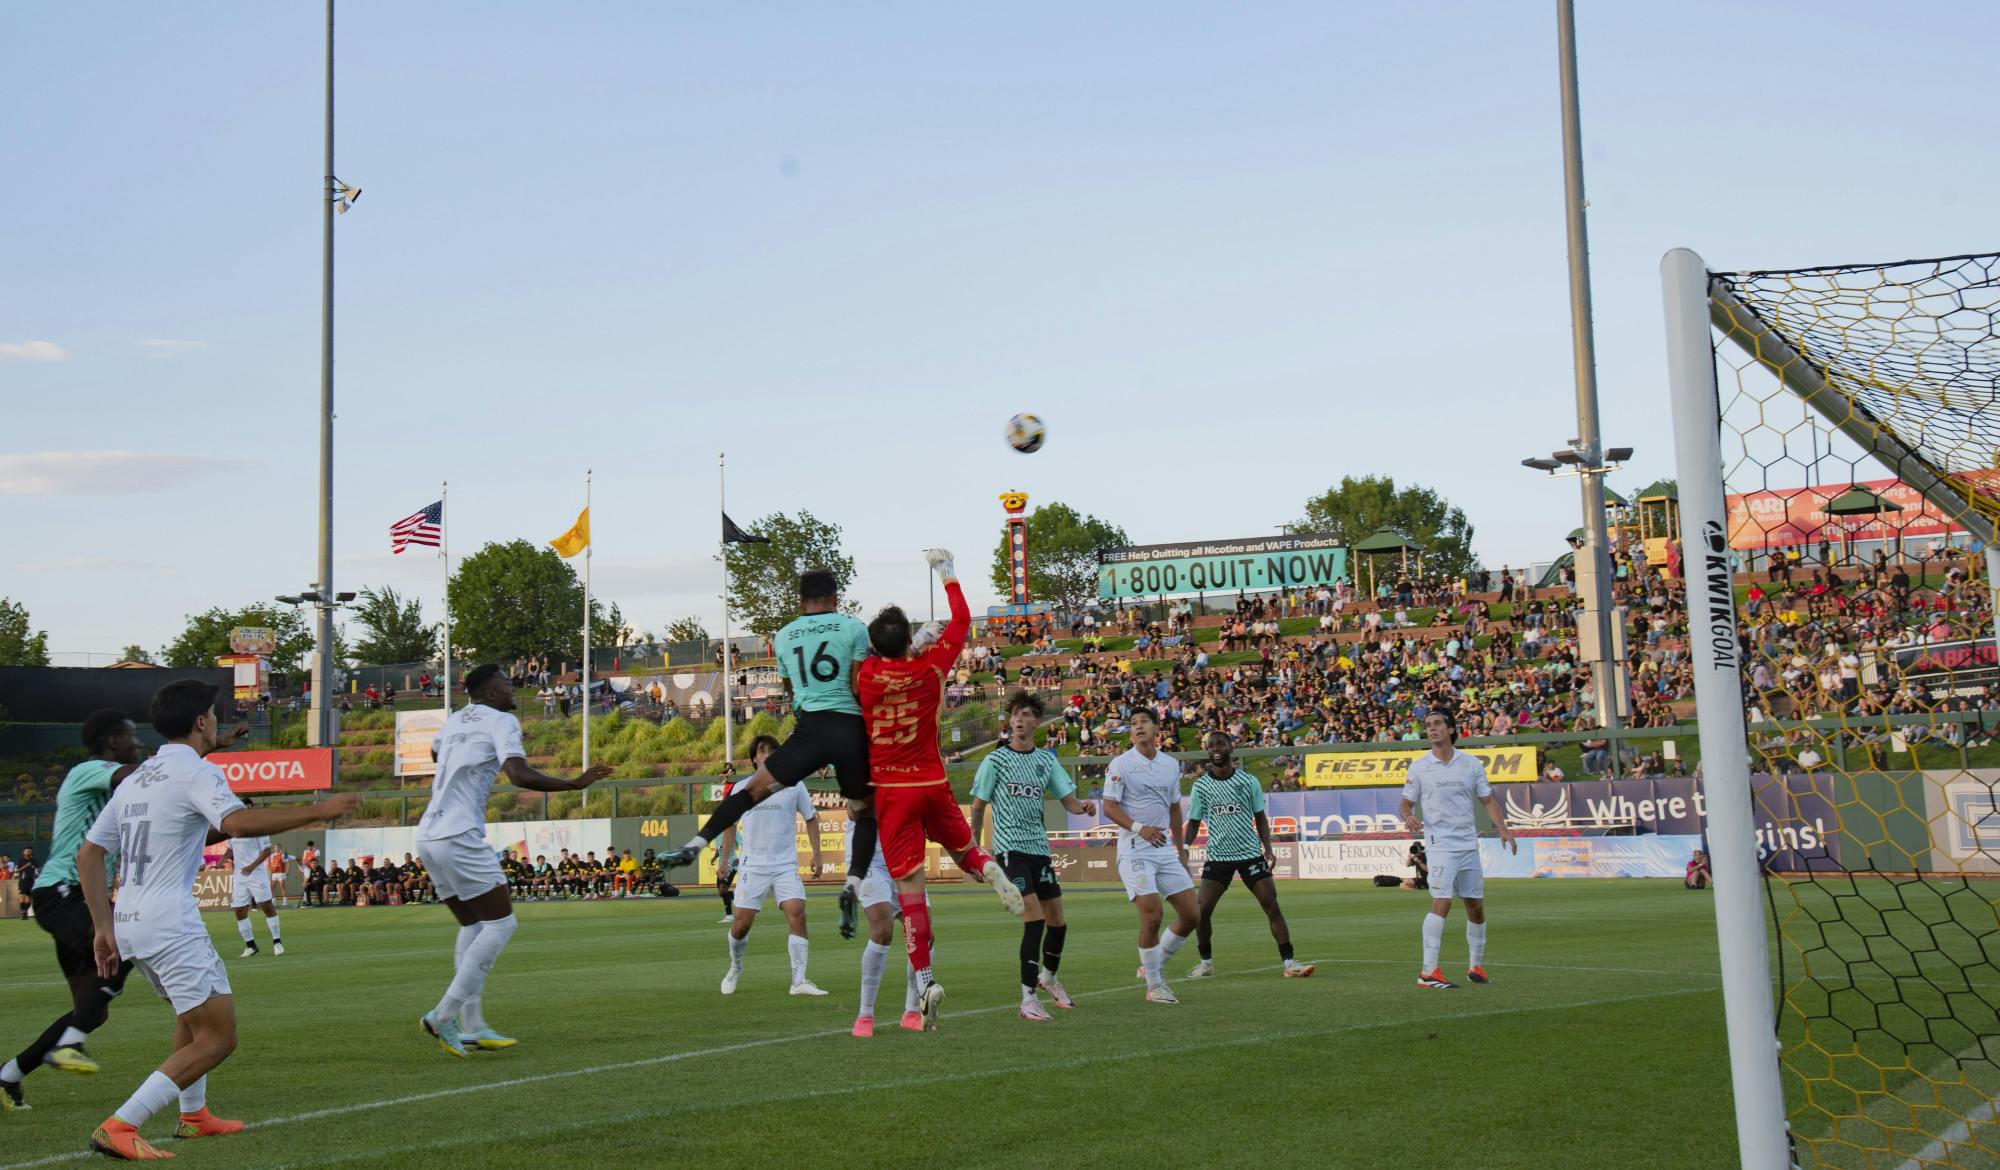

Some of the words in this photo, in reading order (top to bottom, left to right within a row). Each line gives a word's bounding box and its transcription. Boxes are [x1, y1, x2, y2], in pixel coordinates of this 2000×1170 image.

[1102, 551, 1127, 562] FREE
[1128, 550, 1150, 562] Help
[1151, 548, 1190, 560] Quitting
[1191, 546, 1203, 556] all
[1204, 544, 1245, 555] Nicotine
[1245, 542, 1264, 553] and
[1265, 540, 1293, 551] VAPE
[1293, 537, 1339, 549] Products
[788, 623, 841, 641] SEYMORE
[793, 641, 840, 688] 16
[871, 701, 919, 744] 25
[220, 761, 305, 781] TOYOTA
[1315, 755, 1413, 774] FIESTA
[1315, 771, 1354, 780] AUTO
[1364, 770, 1406, 780] GROU
[1007, 782, 1042, 799] TAOS
[1213, 803, 1242, 816] TAOS
[1587, 795, 1687, 823] Where
[640, 819, 669, 838] 404
